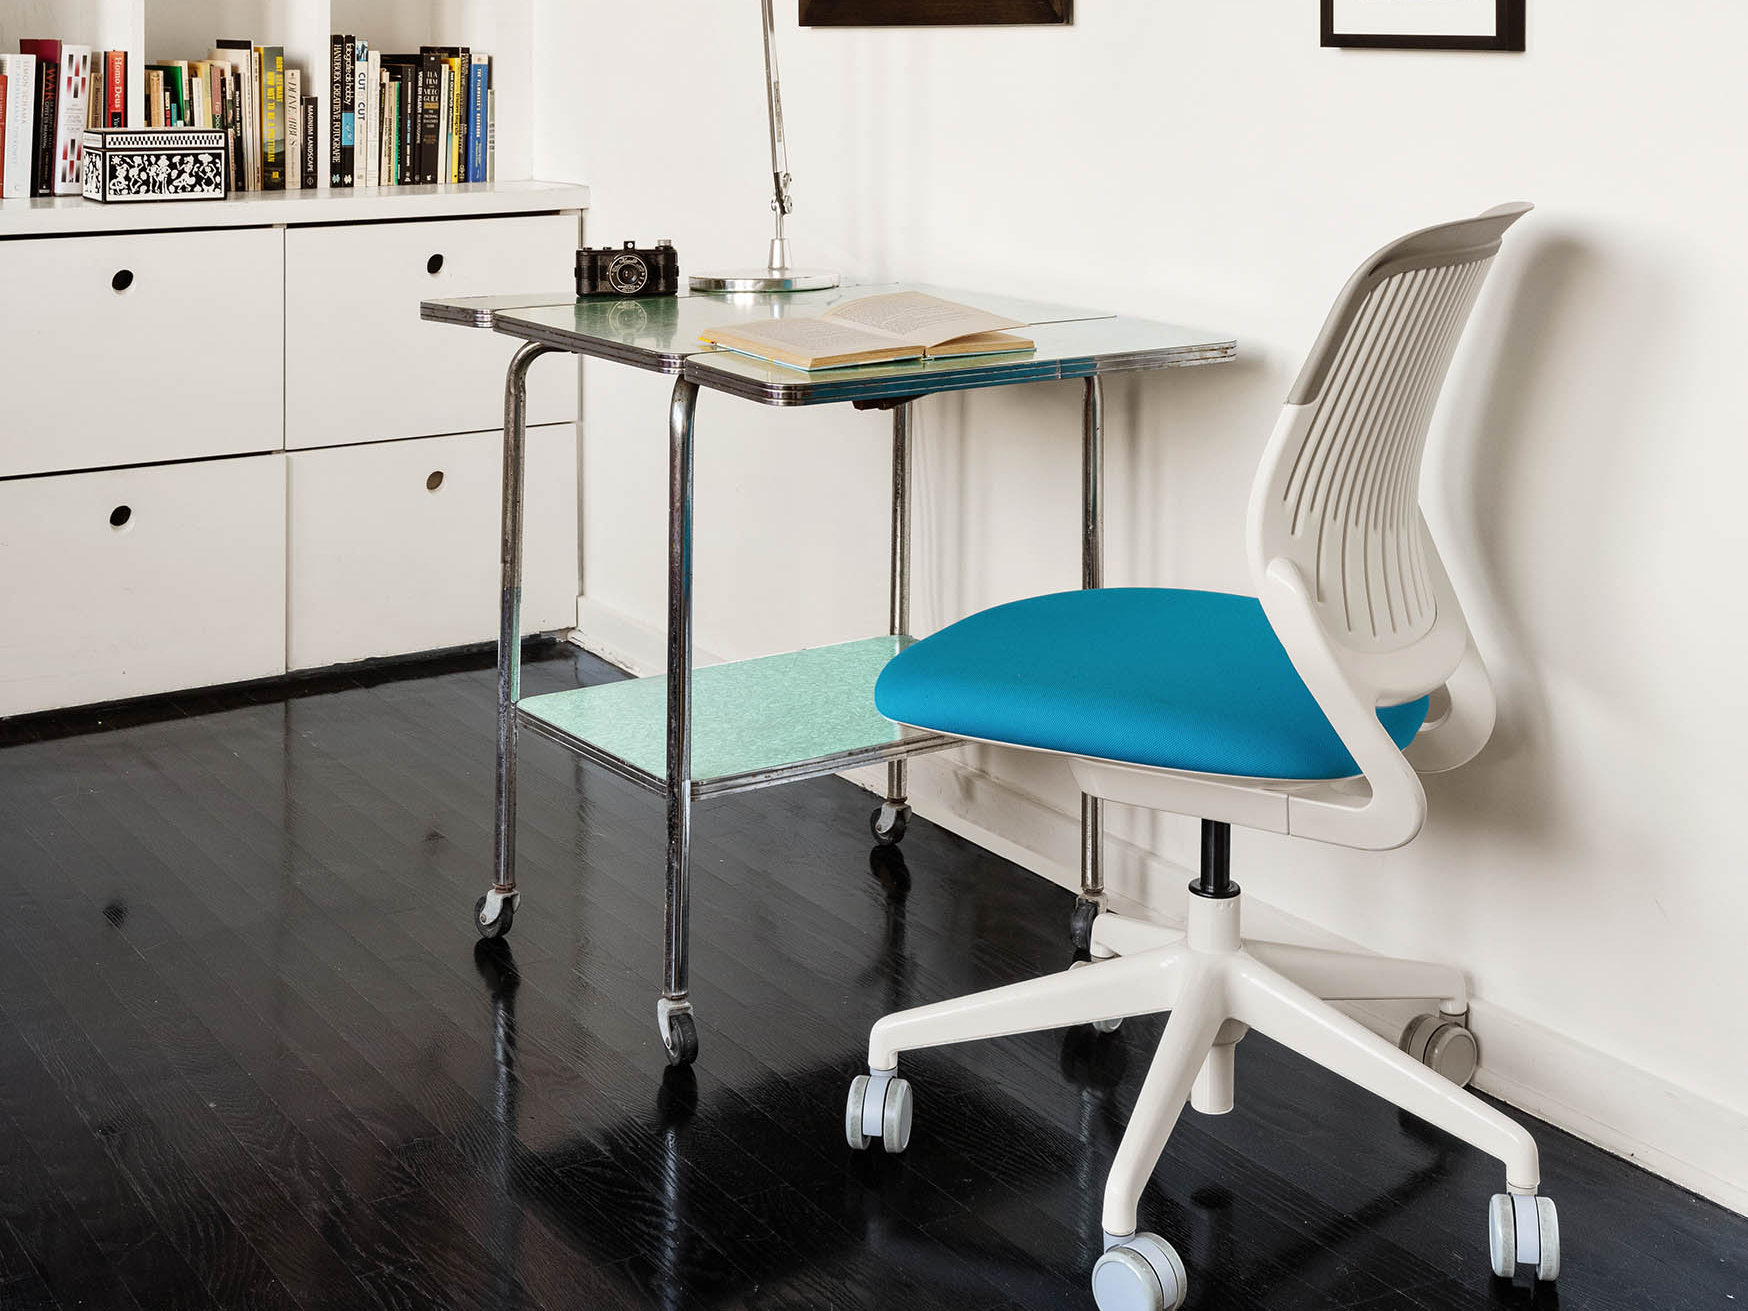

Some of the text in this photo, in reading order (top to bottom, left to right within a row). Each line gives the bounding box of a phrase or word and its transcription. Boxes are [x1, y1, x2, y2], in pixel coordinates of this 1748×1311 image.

[344, 43, 354, 73] fotografie
[45, 68, 56, 101] WAR
[344, 82, 353, 106] hobby
[288, 81, 297, 147] DIANE ARBUS
